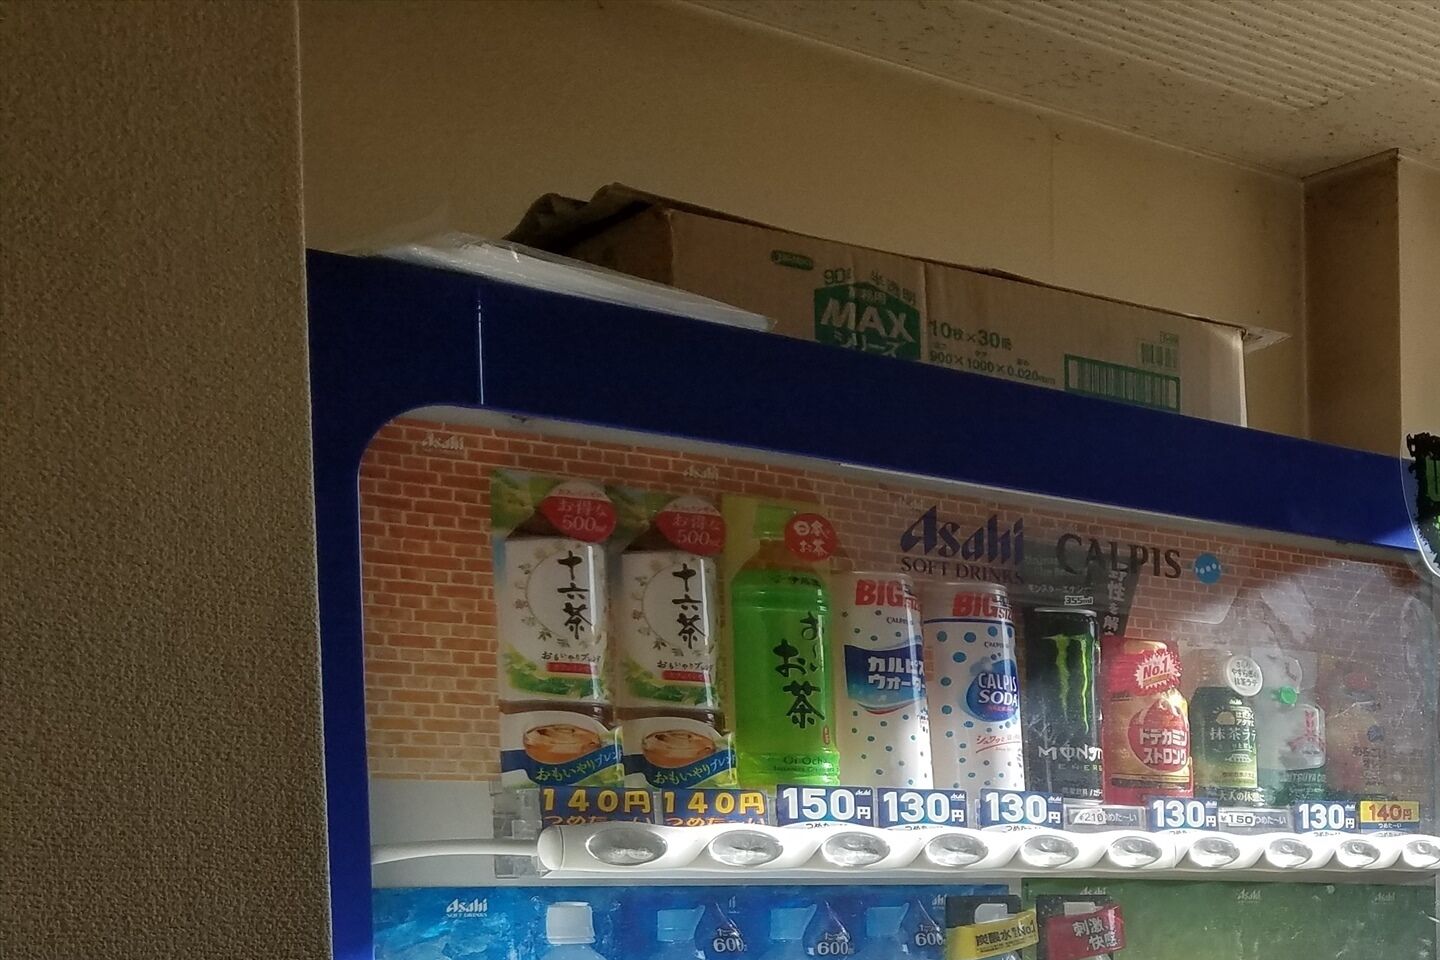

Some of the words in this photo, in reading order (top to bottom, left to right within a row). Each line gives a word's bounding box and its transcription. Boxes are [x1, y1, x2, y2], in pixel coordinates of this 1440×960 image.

[820, 298, 914, 343] MAX
[900, 505, 1024, 566] Asahi
[1055, 532, 1183, 579] CALPIS
[900, 556, 950, 577] SOFT
[955, 563, 1024, 584] DRINKS
[557, 550, 594, 640] 十六茶
[671, 562, 707, 649] 十六茶
[855, 578, 906, 607] BIG
[952, 591, 997, 618] BIG
[1142, 658, 1170, 678] No.1
[772, 638, 825, 729] お茶
[977, 672, 1018, 693] CALPIS
[977, 690, 1019, 707] SODA
[1139, 727, 1188, 746] ドテカミン
[1143, 746, 1188, 765] ストロング
[543, 788, 652, 814] 140円
[664, 789, 766, 815] 140円
[782, 787, 872, 821] 150円
[883, 791, 965, 823] 130円
[985, 791, 1062, 825] 130円
[1152, 799, 1217, 828] 130円
[1368, 804, 1413, 822] 140円
[1298, 803, 1356, 830] 130円
[446, 899, 489, 915] Asahi
